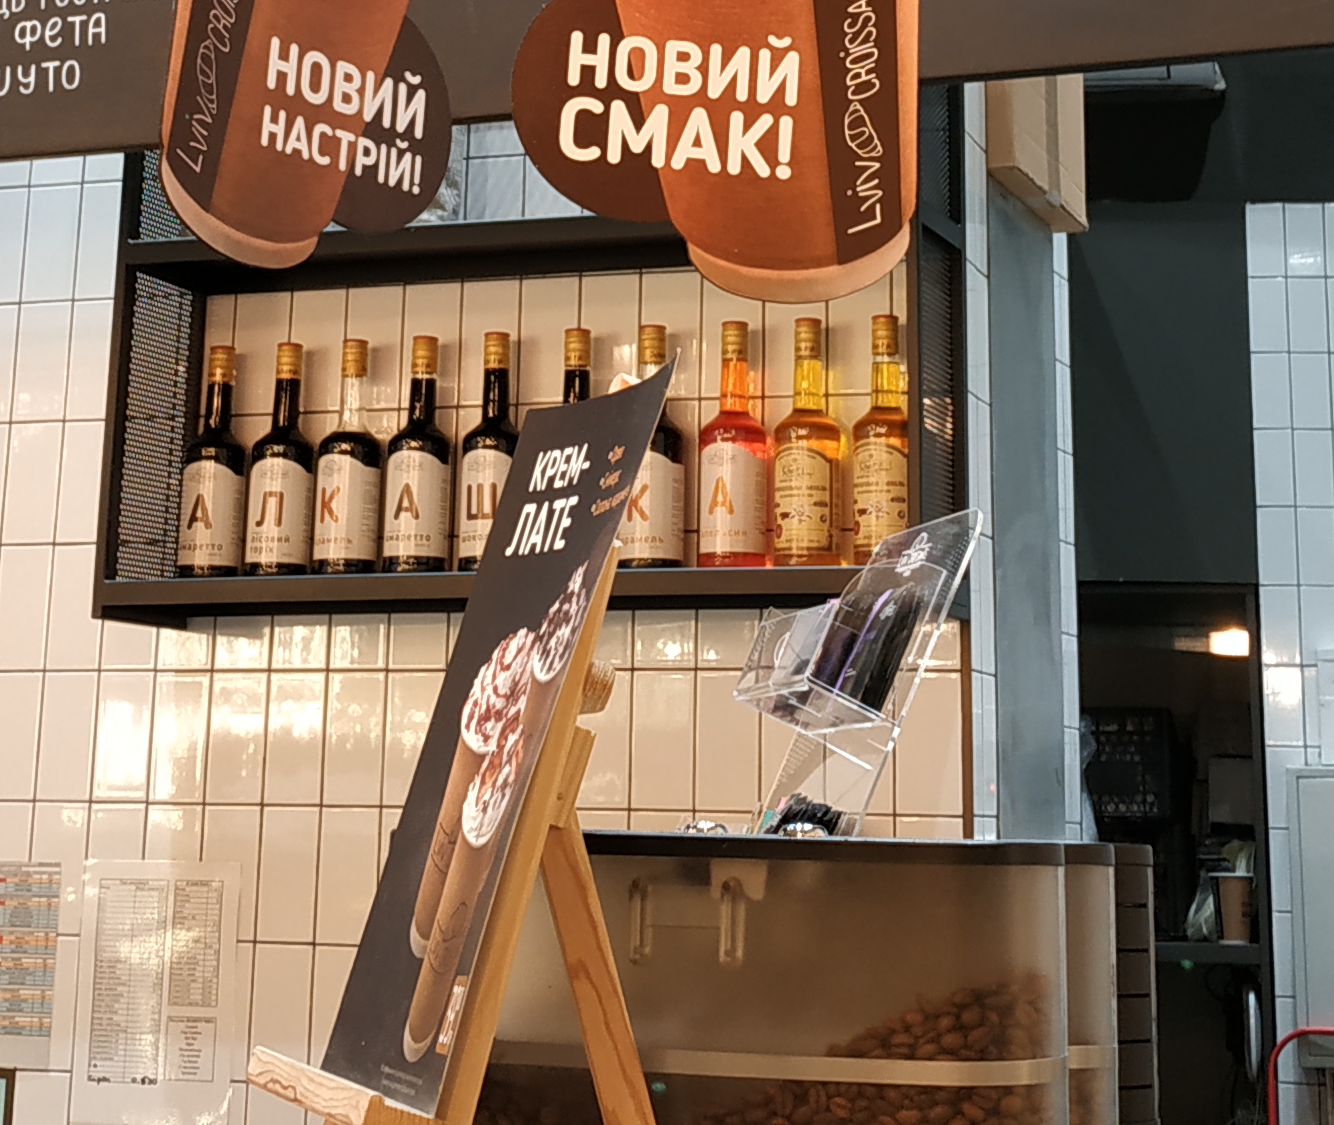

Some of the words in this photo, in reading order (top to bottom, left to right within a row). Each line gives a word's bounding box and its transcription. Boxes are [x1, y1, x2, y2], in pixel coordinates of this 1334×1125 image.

[15, 13, 105, 50] ФЕТА
[267, 36, 426, 140] НОВИЙ
[566, 30, 800, 106] НОВИЙ
[261, 104, 422, 195] НАСТРІЙ!
[559, 96, 794, 181] СМАК!
[529, 443, 591, 493] КРЕМ-
[187, 493, 212, 531] А
[255, 490, 284, 527] Л
[320, 485, 340, 525] К
[393, 482, 420, 521] А
[467, 482, 497, 521] Ш
[708, 476, 735, 516] А
[504, 495, 579, 557] ЛАТЕ
